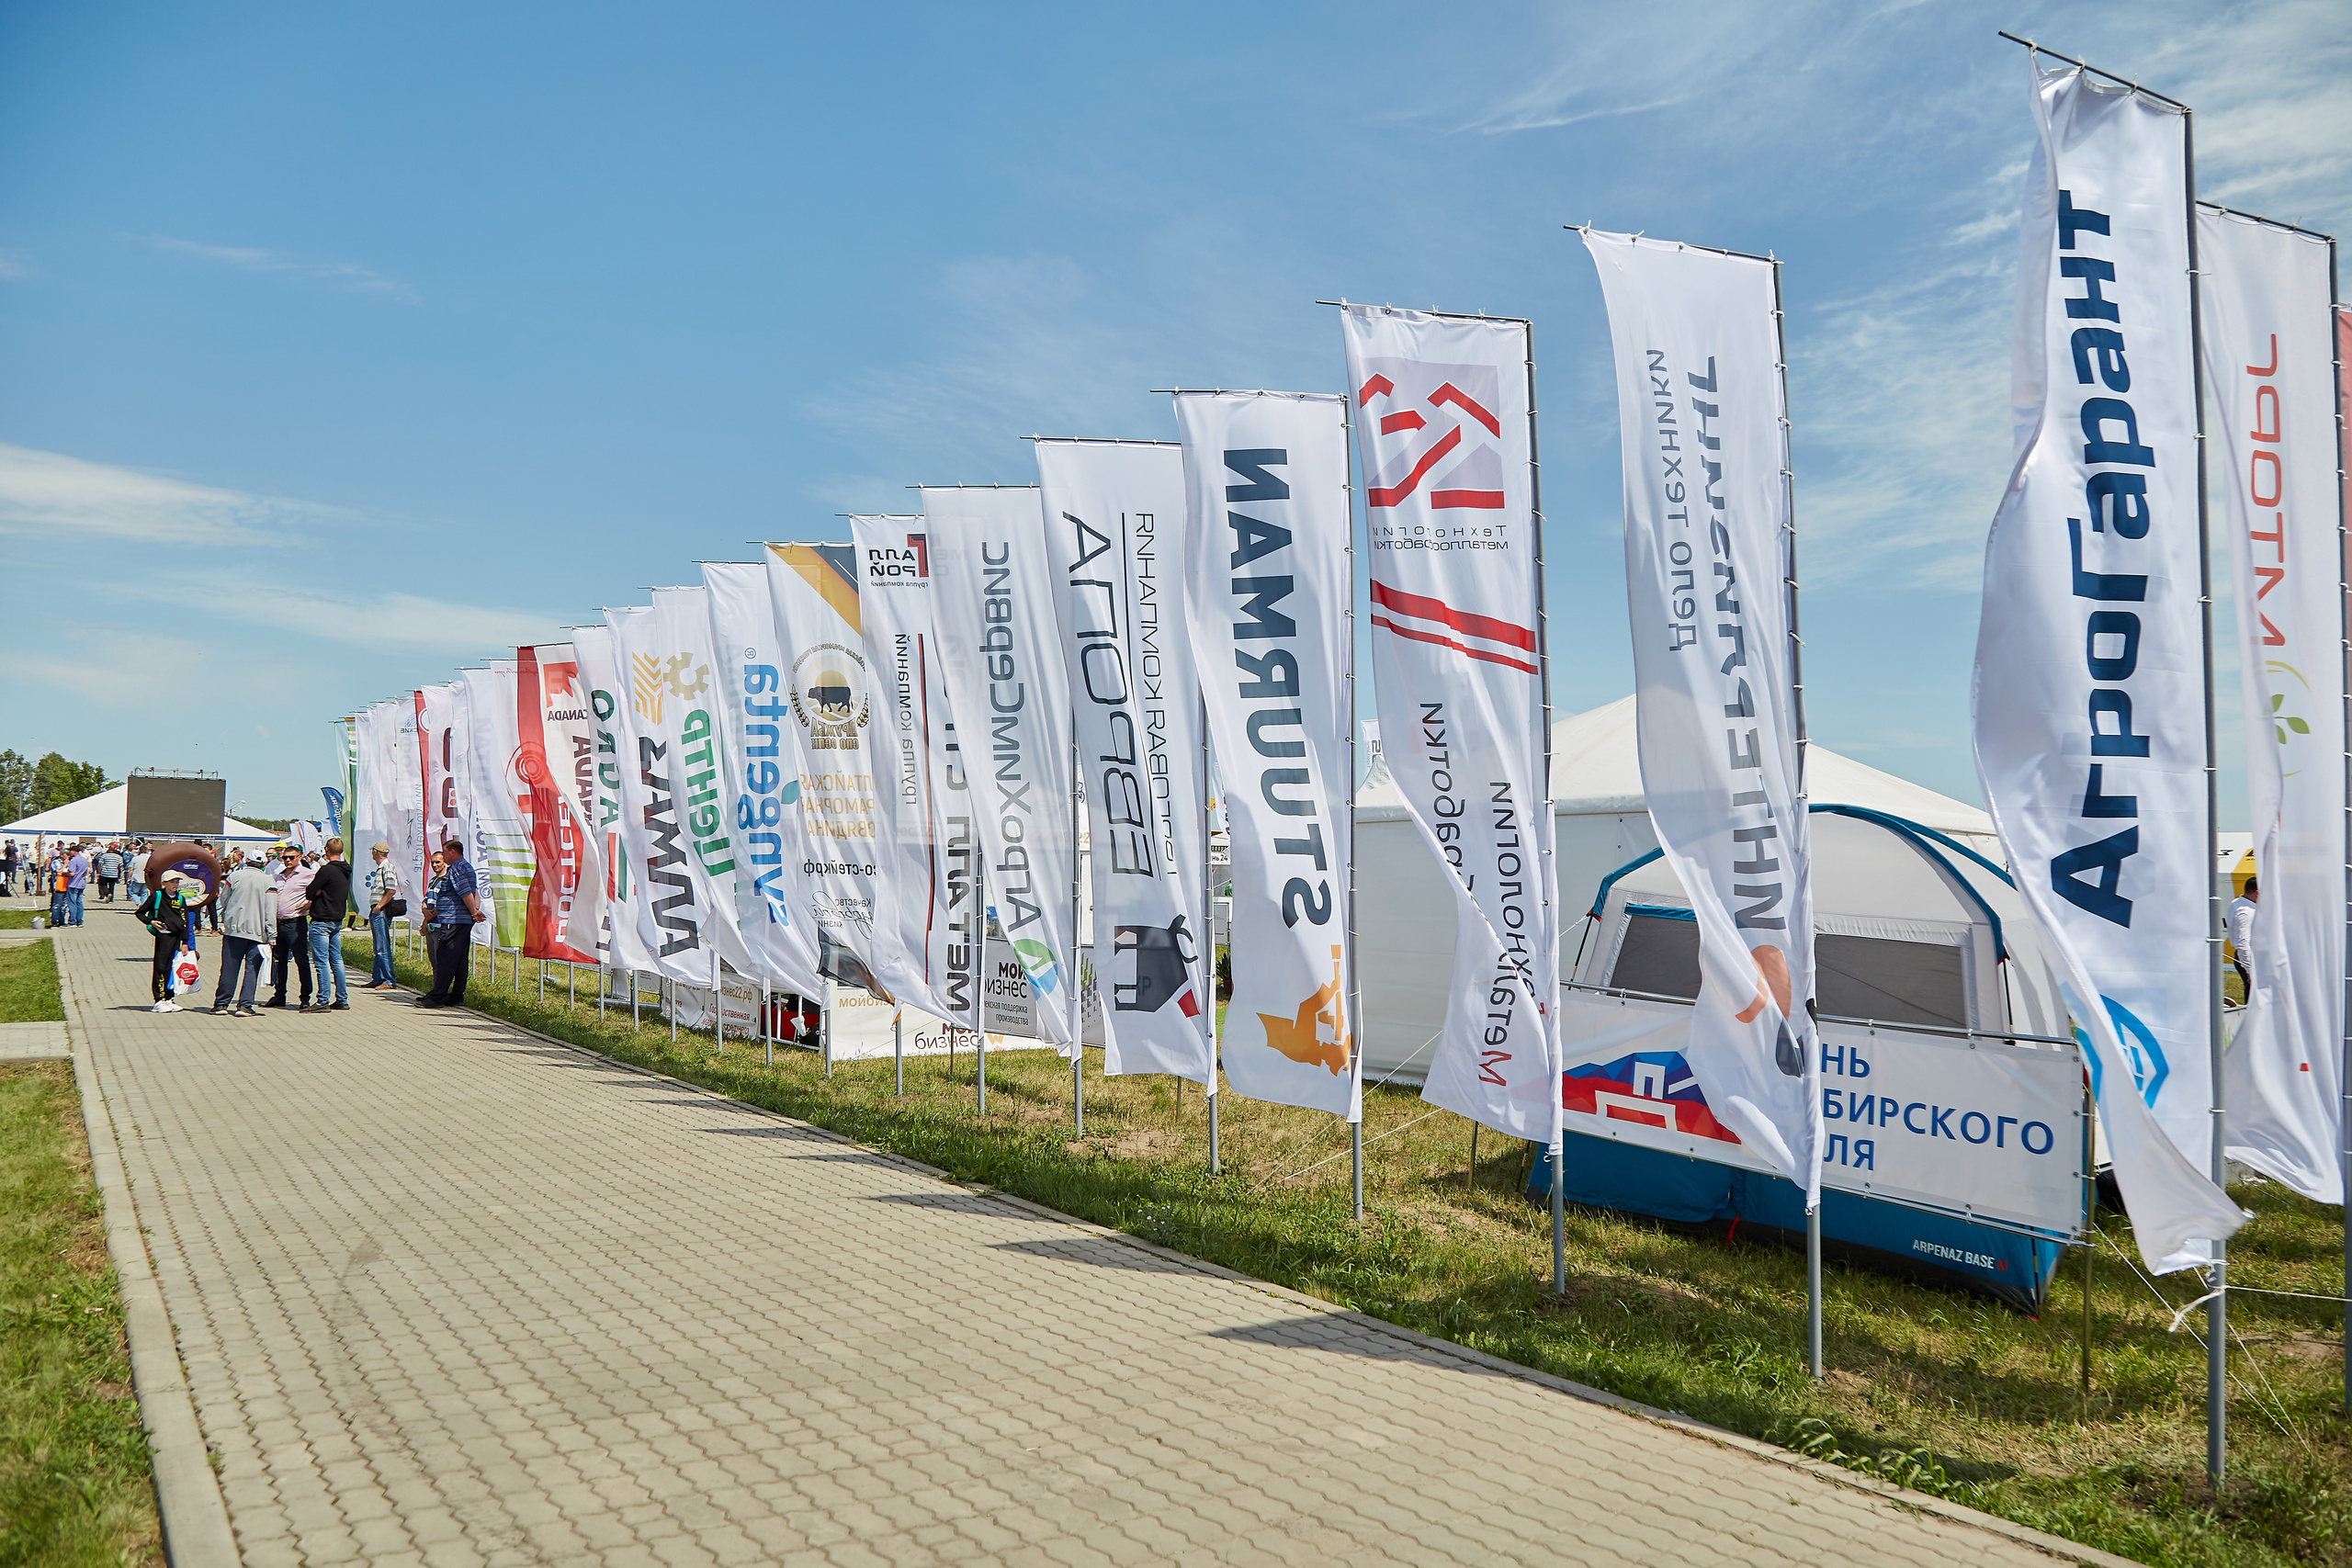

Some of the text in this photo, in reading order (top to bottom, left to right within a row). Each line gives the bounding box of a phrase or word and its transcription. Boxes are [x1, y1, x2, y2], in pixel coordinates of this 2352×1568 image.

[2050, 189, 2155, 929] АгроГарант
[1912, 1239, 1963, 1263] ARPENAZ
[1964, 1250, 1995, 1269] BASE
